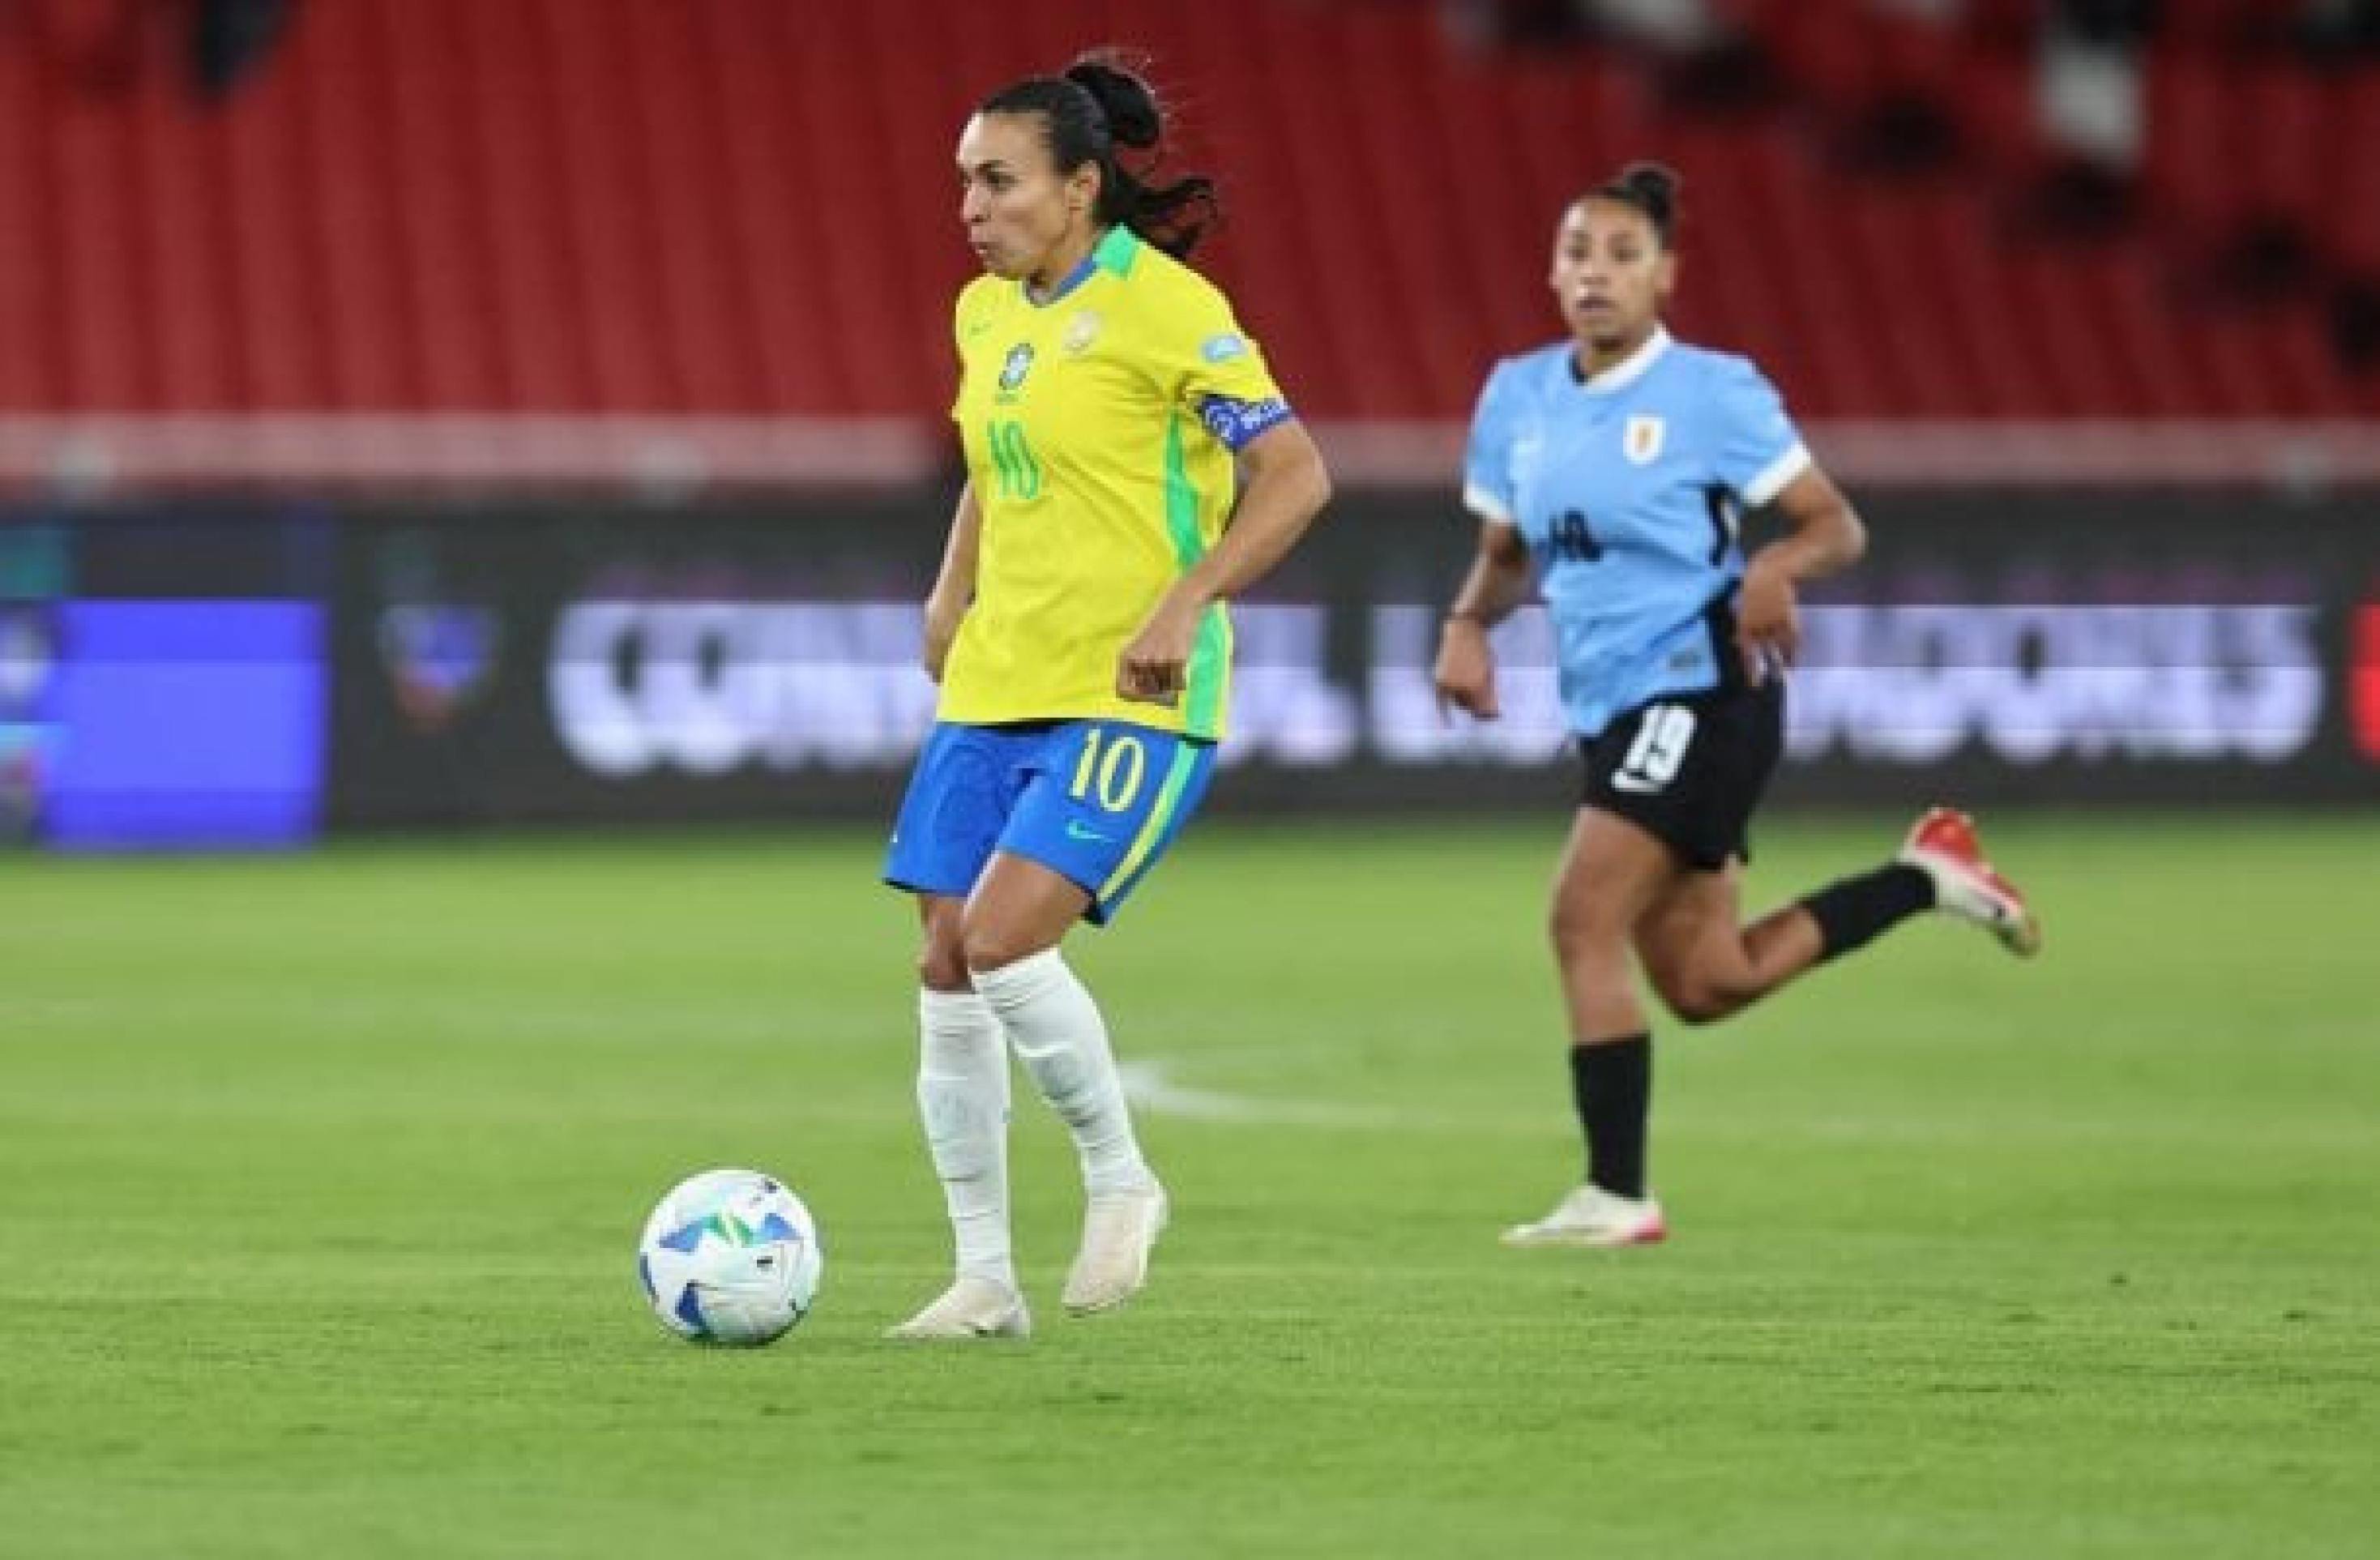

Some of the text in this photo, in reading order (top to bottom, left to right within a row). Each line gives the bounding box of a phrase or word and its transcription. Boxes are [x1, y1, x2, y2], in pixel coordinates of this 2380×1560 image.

[987, 421, 1040, 499] 10
[1069, 729, 1145, 813] 10
[1623, 703, 1698, 782] 19
